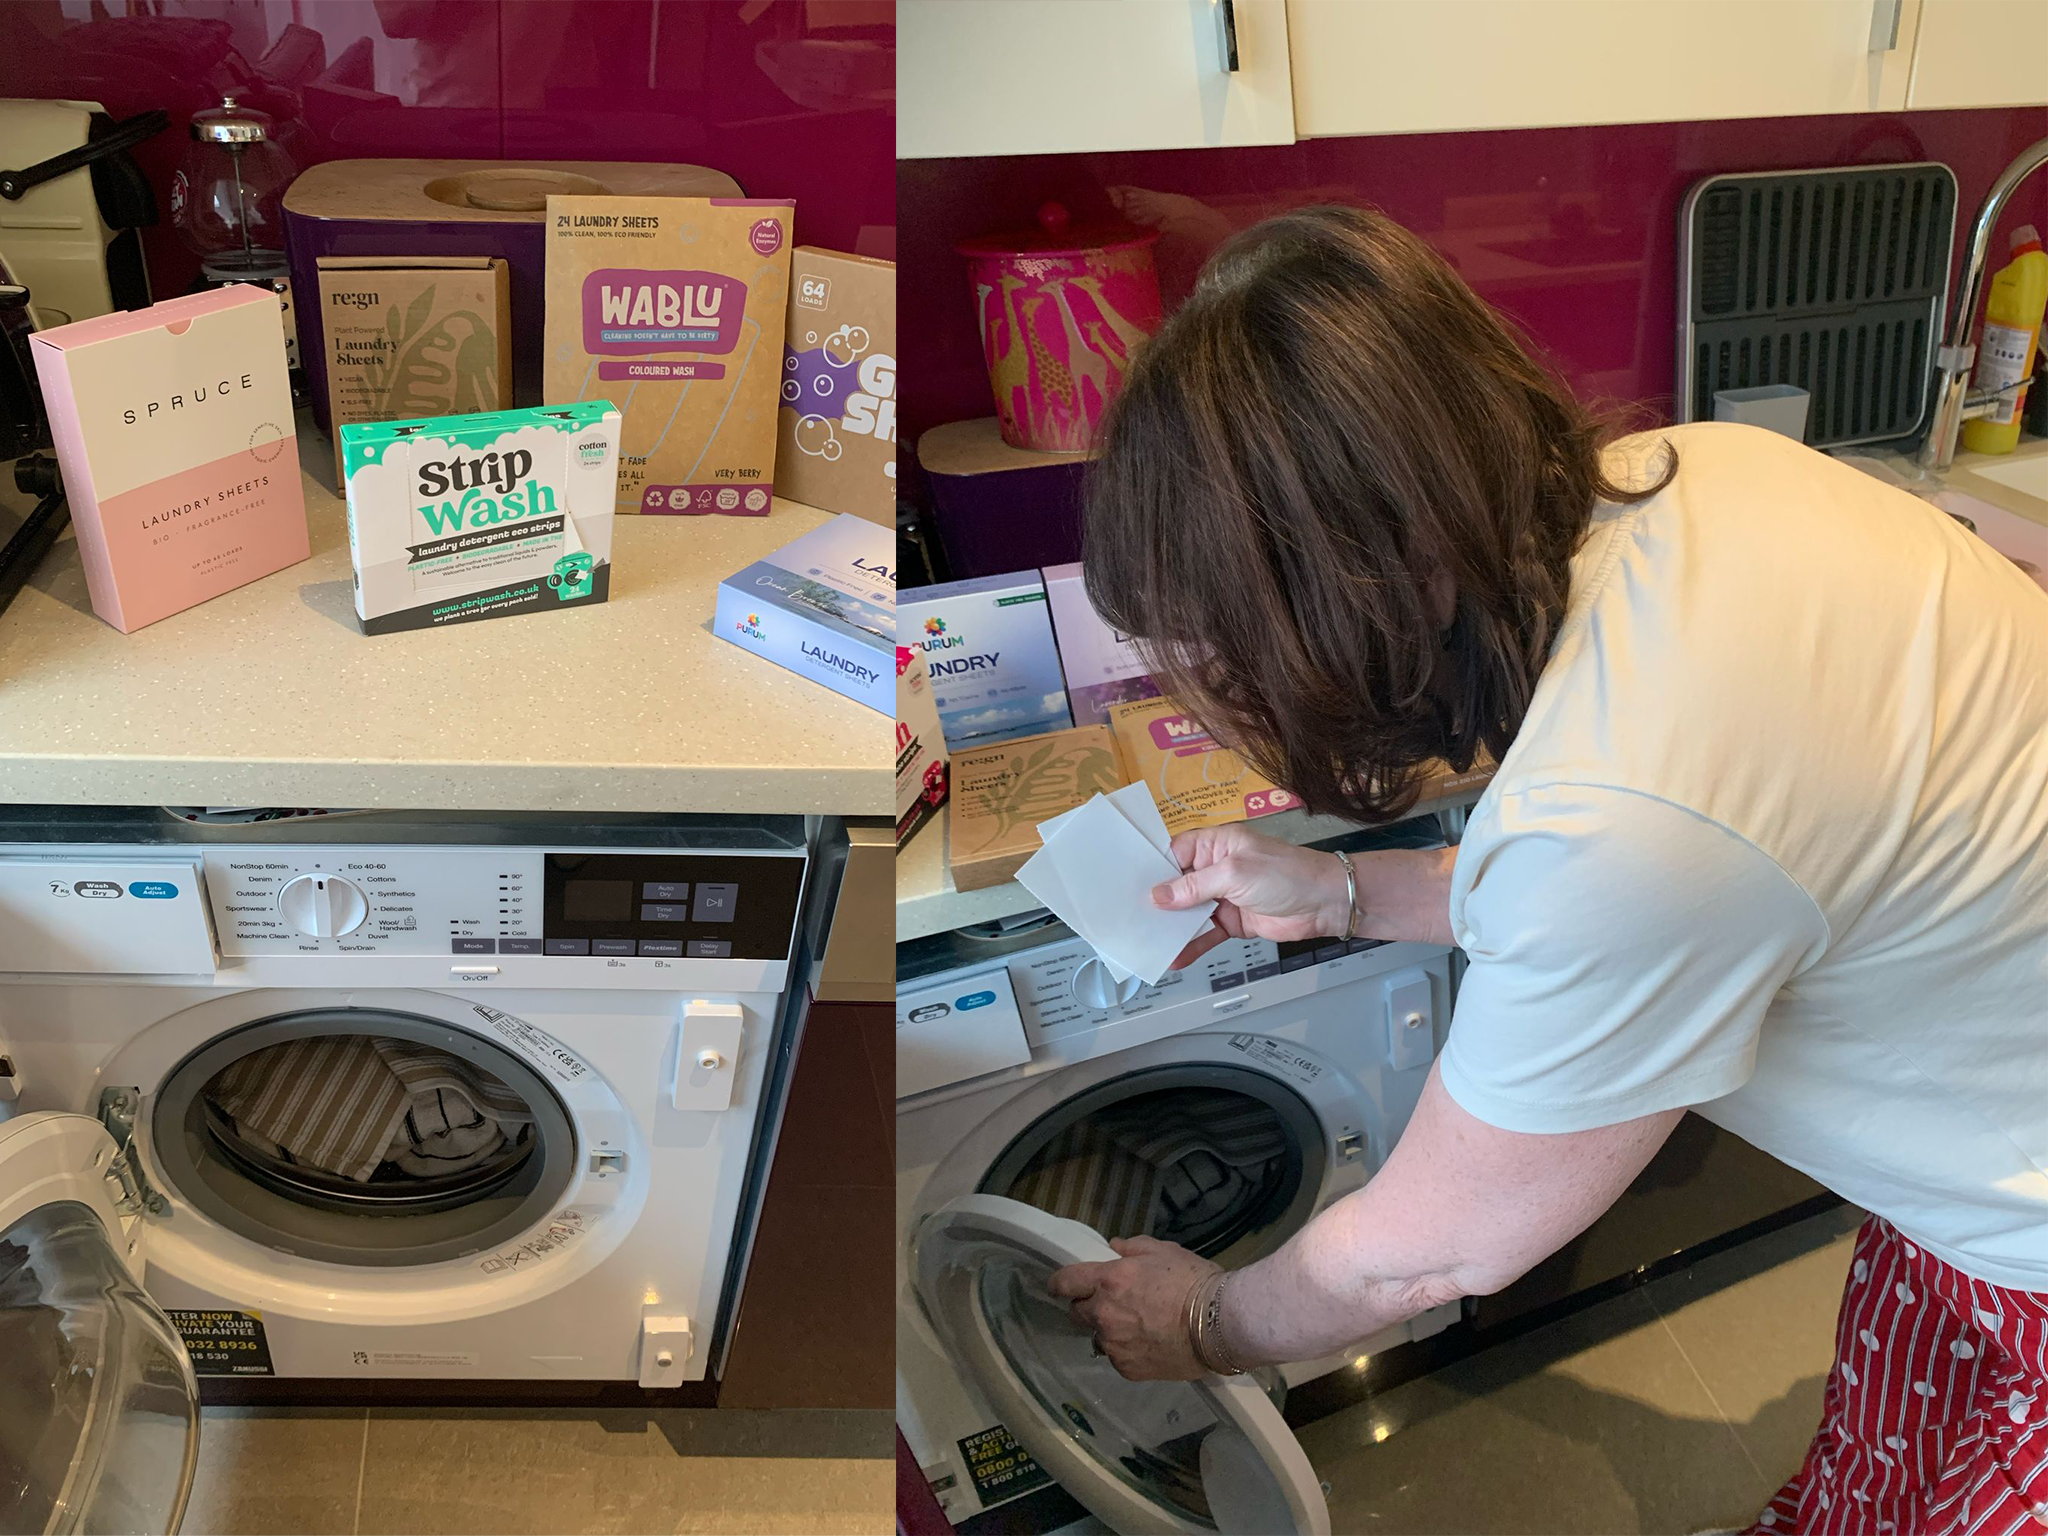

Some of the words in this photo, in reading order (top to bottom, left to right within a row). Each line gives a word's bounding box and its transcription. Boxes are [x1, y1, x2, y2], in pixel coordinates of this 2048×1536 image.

[557, 216, 570, 227] 24
[574, 216, 619, 227] LAUNDRY
[622, 216, 659, 228] SHEETS
[803, 280, 825, 298] 64
[332, 292, 379, 310] re:gn
[601, 284, 722, 328] WABLU
[801, 297, 823, 306] LOADS
[335, 338, 399, 353] Laundry
[337, 353, 384, 365] Sheets
[629, 365, 670, 375] COLOURED
[673, 367, 695, 375] WASH
[123, 373, 253, 425] SPRUCE
[579, 441, 607, 451] cotton
[580, 449, 604, 458] fresh
[418, 449, 532, 497] Strip
[715, 469, 735, 479] VERY
[739, 469, 761, 479] BERRY
[142, 497, 210, 529] LAUNDRY
[218, 476, 269, 501] SHEETS
[417, 479, 558, 536] Wash
[152, 534, 170, 546] BIO
[186, 499, 266, 532] FRAGRANCE-FREE
[419, 542, 457, 556] laundry
[459, 530, 510, 547] detergent
[512, 528, 528, 536] eco
[530, 521, 560, 532] strips
[408, 557, 452, 571] PLASTIC-FREE
[462, 544, 514, 560] BIODEGRADABLE
[756, 576, 788, 592] Ocean
[432, 584, 539, 615] www.stripwash.co.uk
[444, 613, 460, 621] plant
[480, 605, 490, 613] for
[491, 601, 508, 609] every
[524, 593, 538, 602] sold!
[736, 622, 766, 641] PURUM
[801, 641, 880, 684] LAUNDRY
[805, 655, 843, 676] DETERGENT
[844, 674, 870, 689] SHEETS
[960, 670, 995, 682] SHEETS
[1186, 791, 1223, 803] REMOVES
[1196, 801, 1217, 810] LOVE
[51, 885, 59, 893] 7
[462, 974, 488, 982] On/Off
[1037, 982, 1062, 991] Outdoor
[219, 1341, 257, 1350] 8936
[970, 1446, 1002, 1463] FREE
[977, 1457, 1014, 1477] 0800
[1018, 1452, 1028, 1462] 0
[992, 1473, 1014, 1486] 800
[1016, 1463, 1036, 1476] 818
